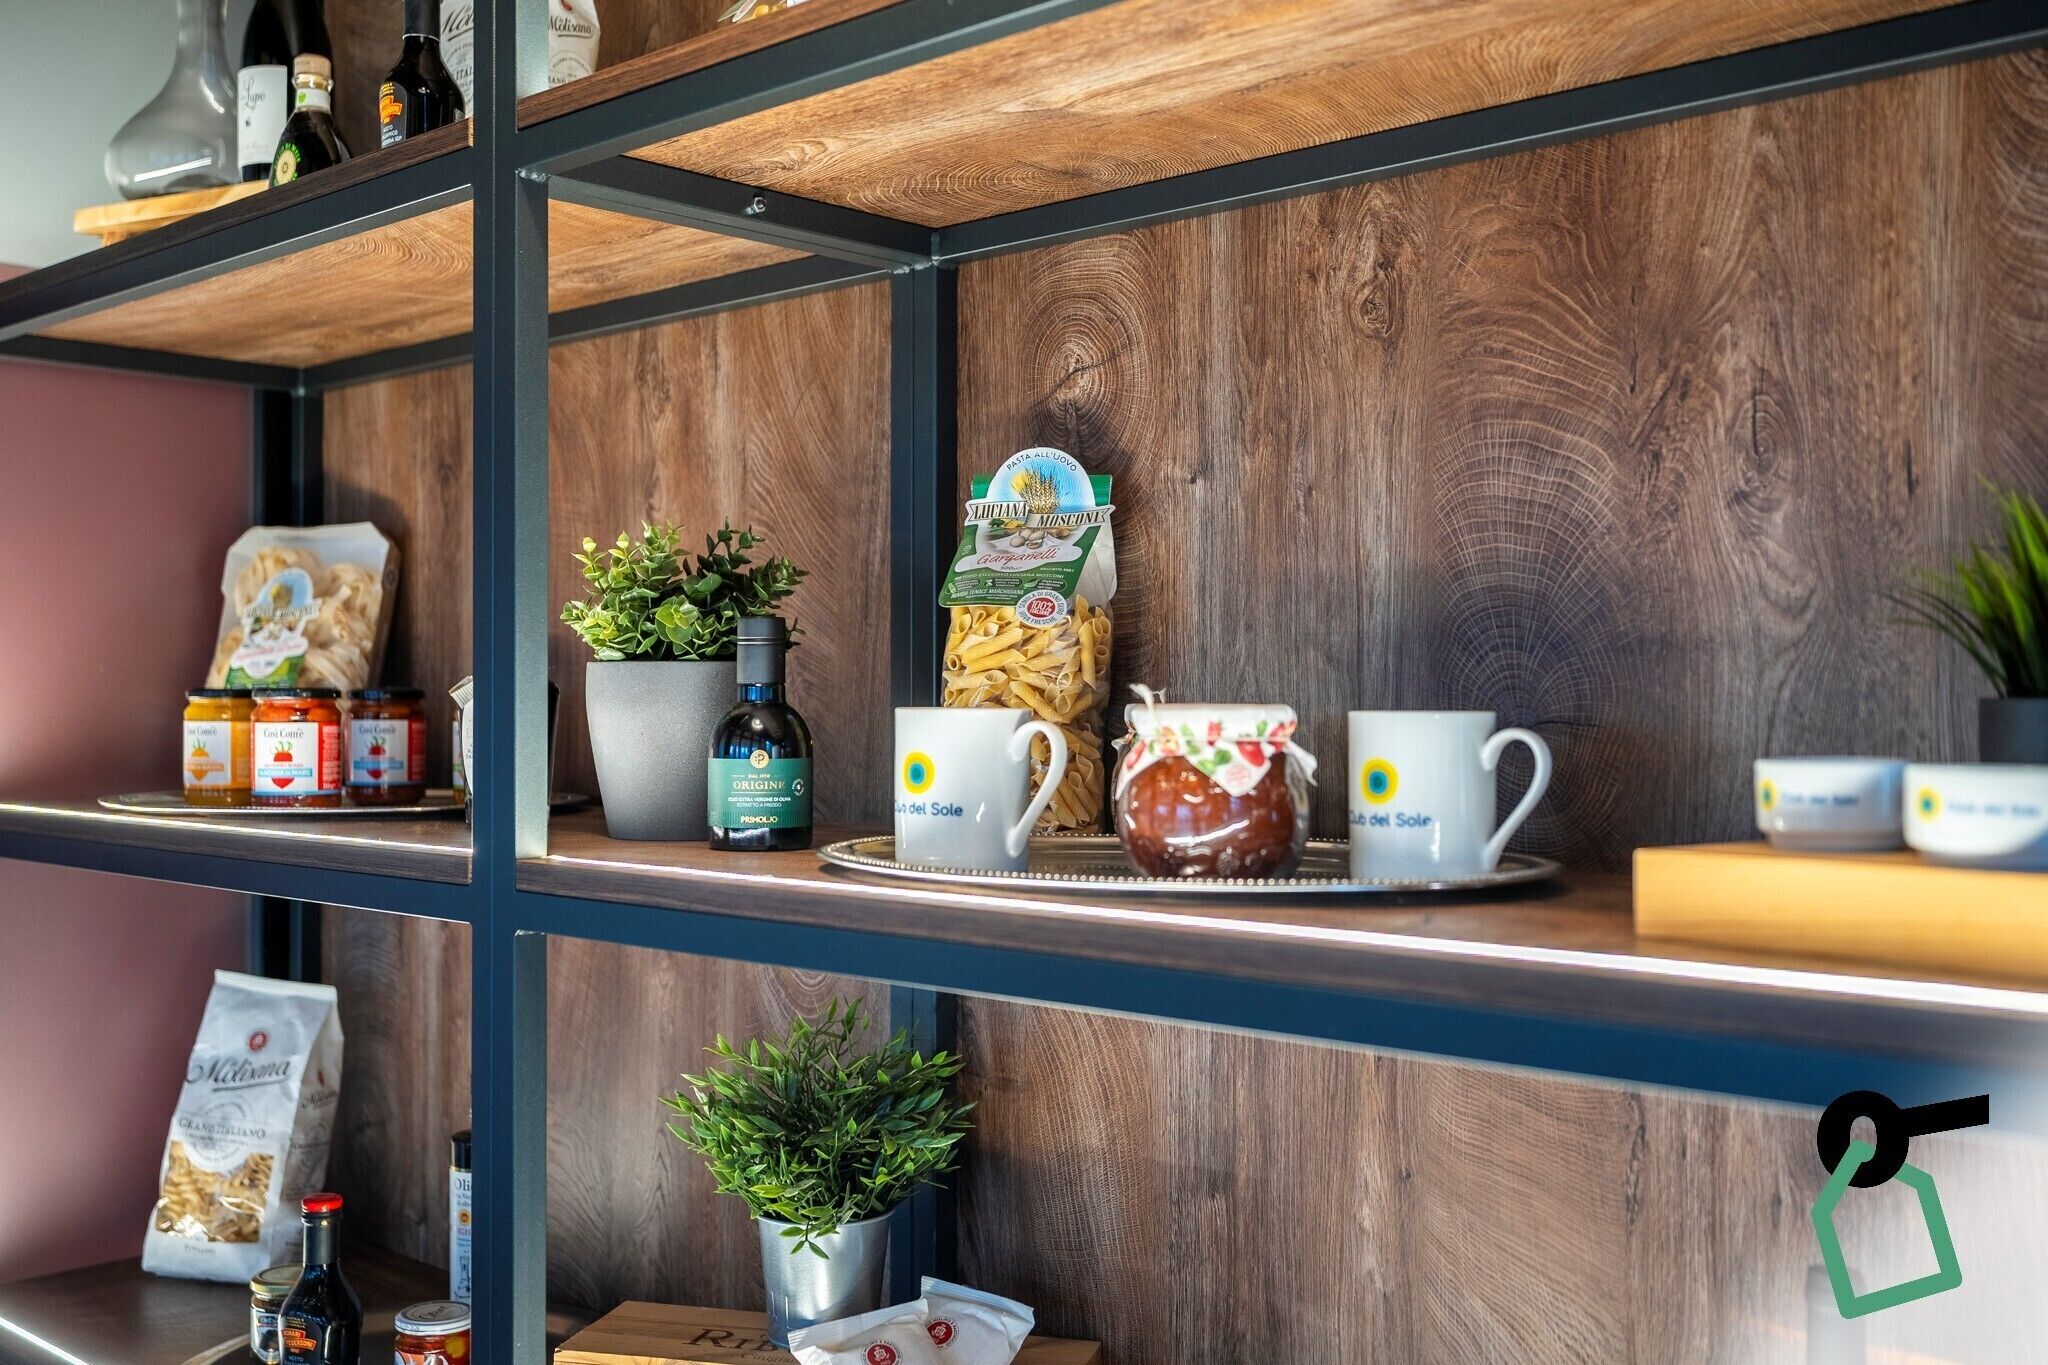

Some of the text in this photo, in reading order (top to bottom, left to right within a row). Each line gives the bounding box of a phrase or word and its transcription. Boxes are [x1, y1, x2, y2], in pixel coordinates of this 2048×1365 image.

[1006, 452, 1077, 472] PASTA ALL'UOVO
[974, 502, 1101, 528] LUCIANA MOSCONI
[977, 546, 1060, 566] Garganelli
[1031, 600, 1054, 612] 100%
[1031, 617, 1058, 625] FRESCHE
[908, 802, 927, 815] del
[931, 802, 963, 817] Sole
[1370, 812, 1390, 827] del
[1396, 812, 1432, 828] Sole
[185, 1056, 295, 1084] Molisana
[454, 1178, 472, 1191] Oli
